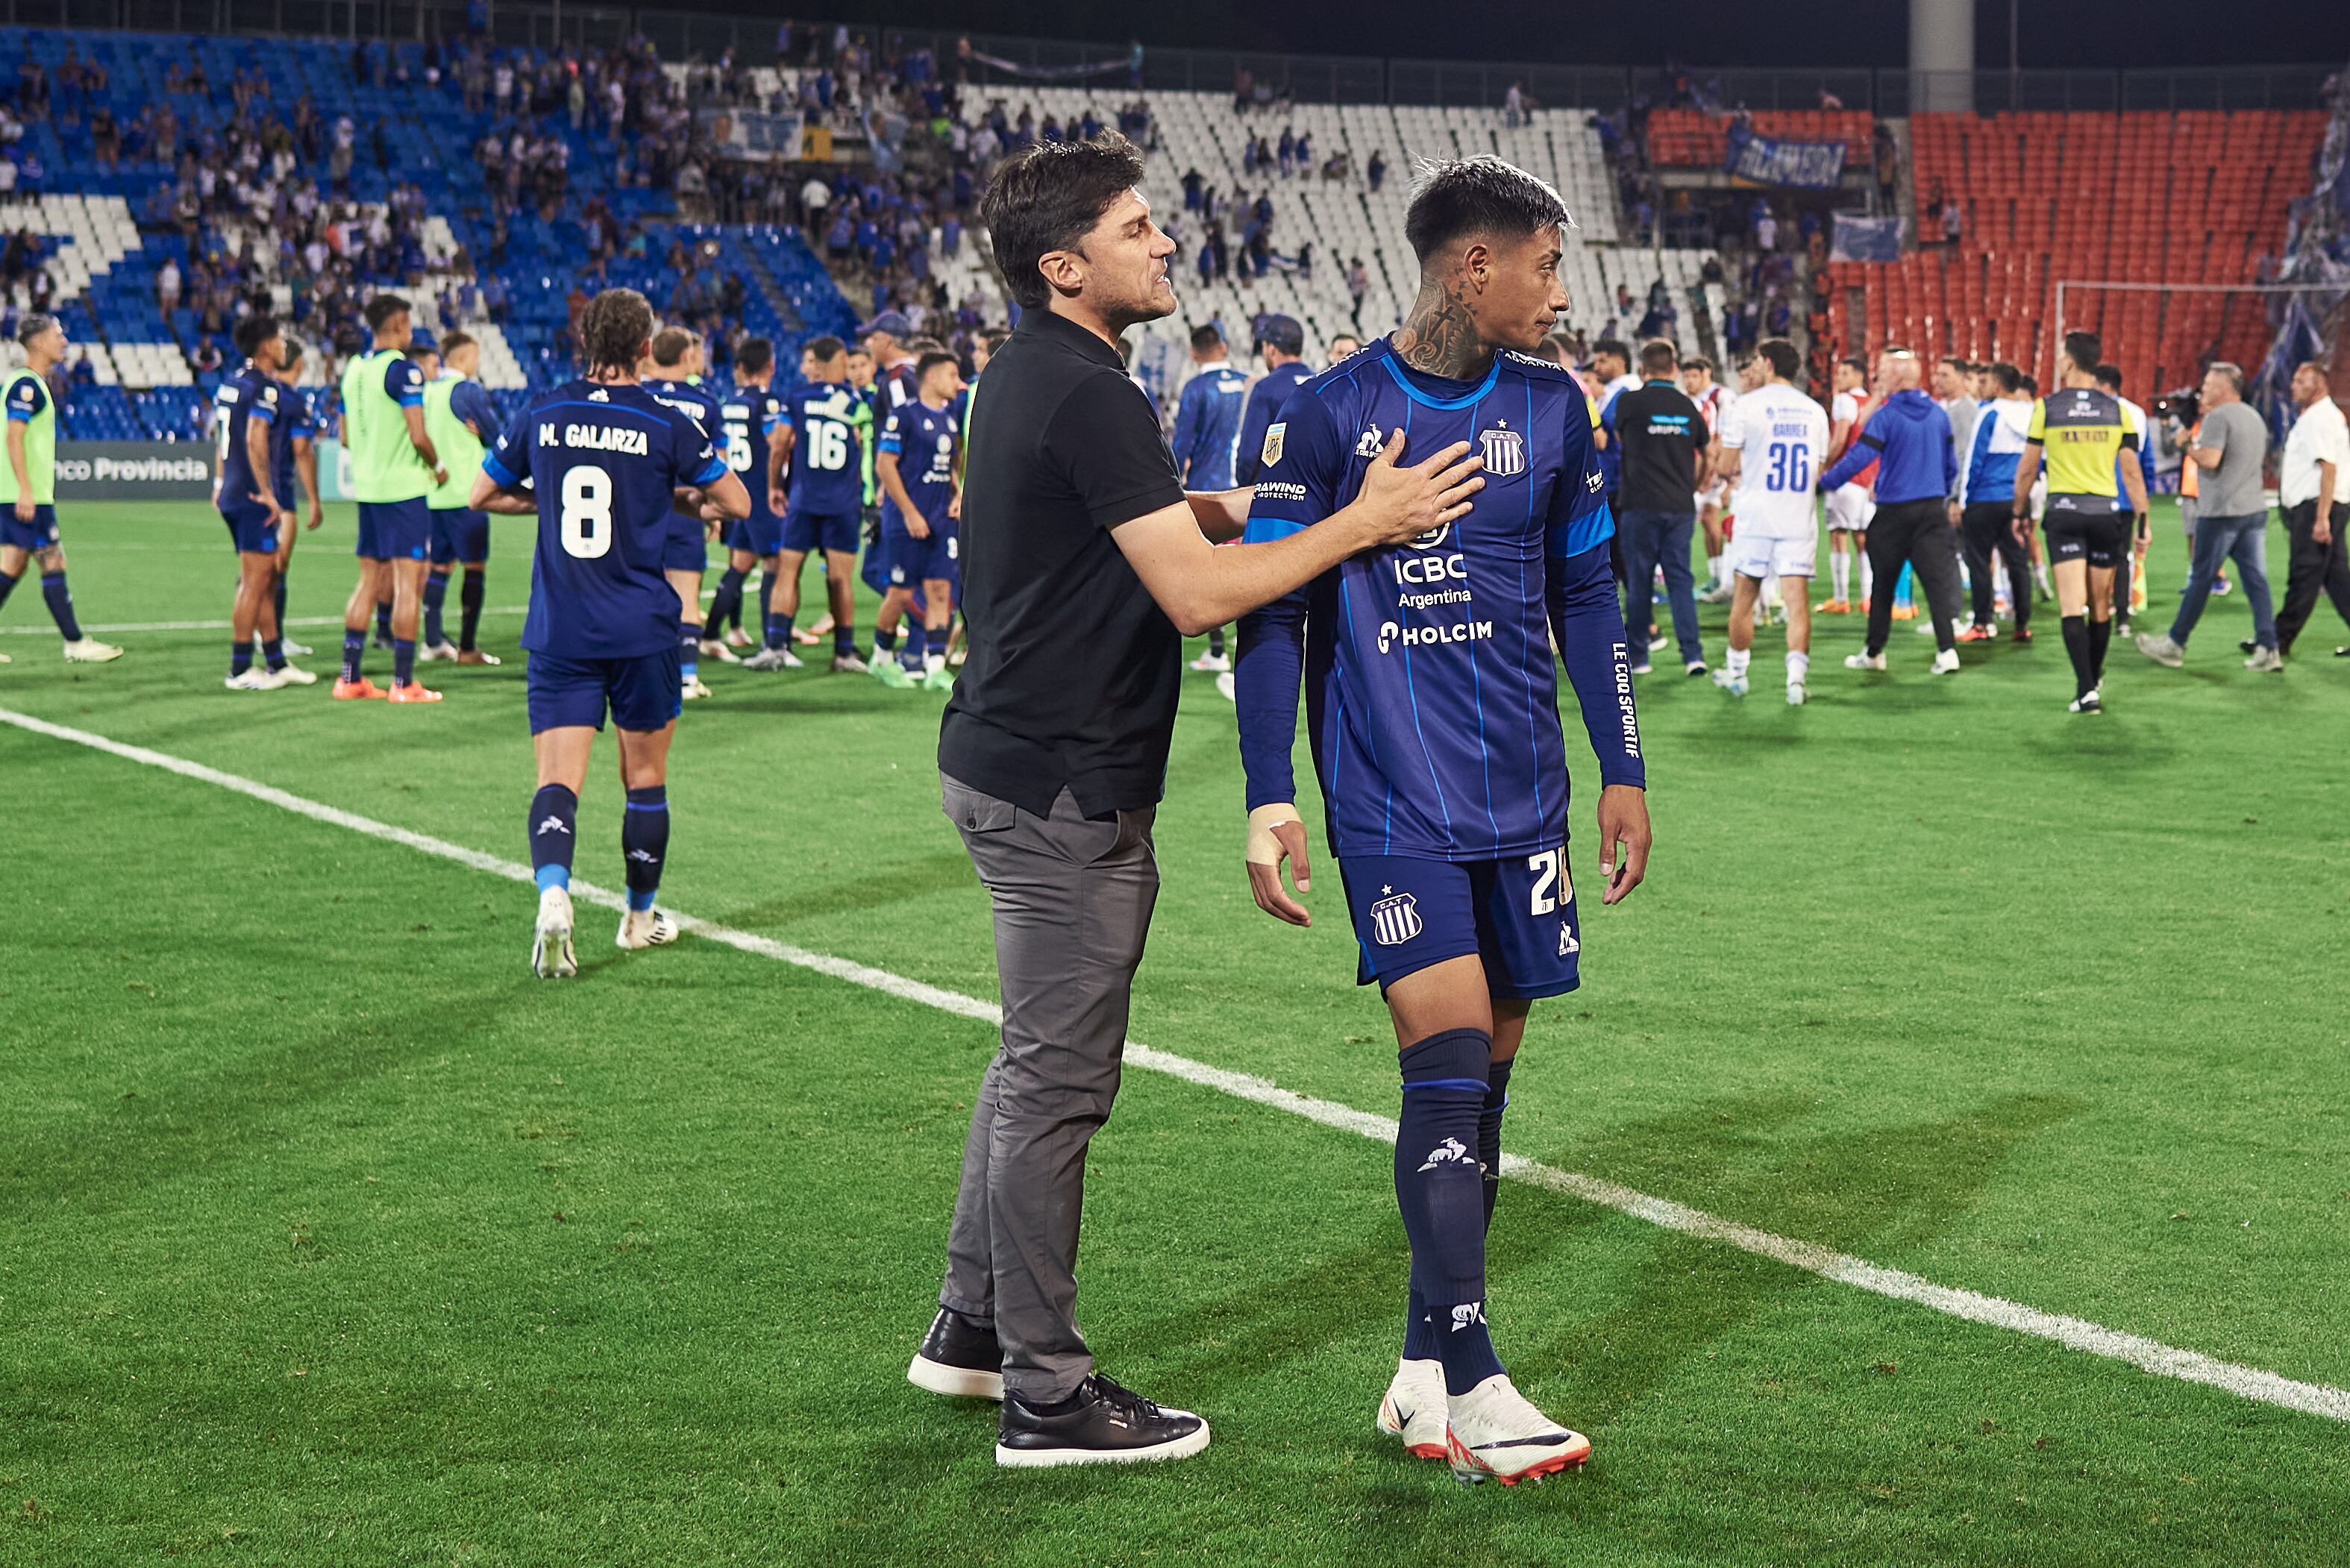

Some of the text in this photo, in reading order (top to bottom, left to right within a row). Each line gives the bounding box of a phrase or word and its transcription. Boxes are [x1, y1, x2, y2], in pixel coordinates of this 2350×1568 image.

[539, 423, 648, 456] M. GALARZA
[805, 418, 848, 471] 16
[94, 457, 208, 481] Provincia
[1766, 442, 1809, 492] 36
[561, 465, 612, 559] 8
[1394, 553, 1467, 585] ICBC
[1398, 589, 1472, 609] Argentina
[1402, 621, 1493, 646] HOLCIM
[1612, 642, 1639, 759] LE COQ SPORTIF
